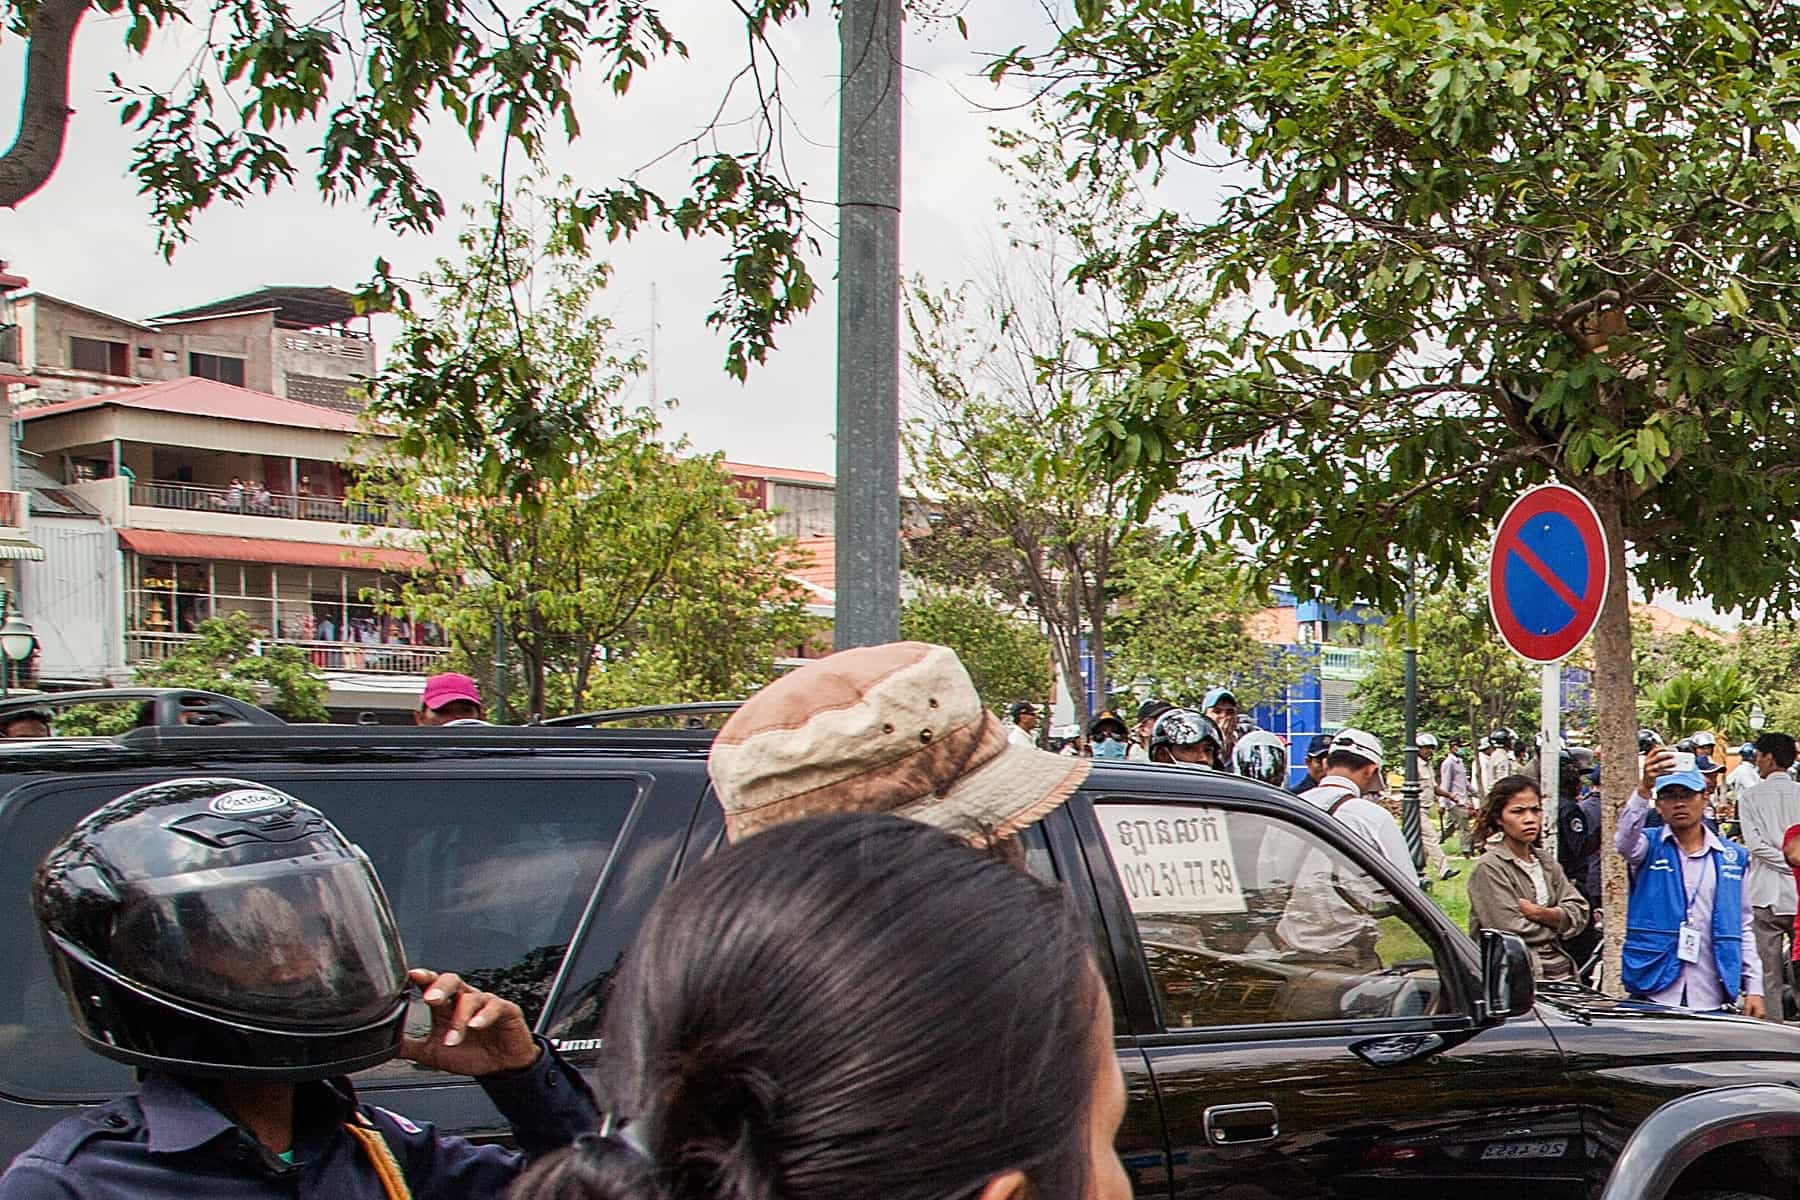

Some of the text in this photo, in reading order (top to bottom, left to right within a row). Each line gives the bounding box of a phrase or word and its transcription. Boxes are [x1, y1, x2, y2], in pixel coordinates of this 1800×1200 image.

[1123, 858, 1234, 898] 012 51 77 59
